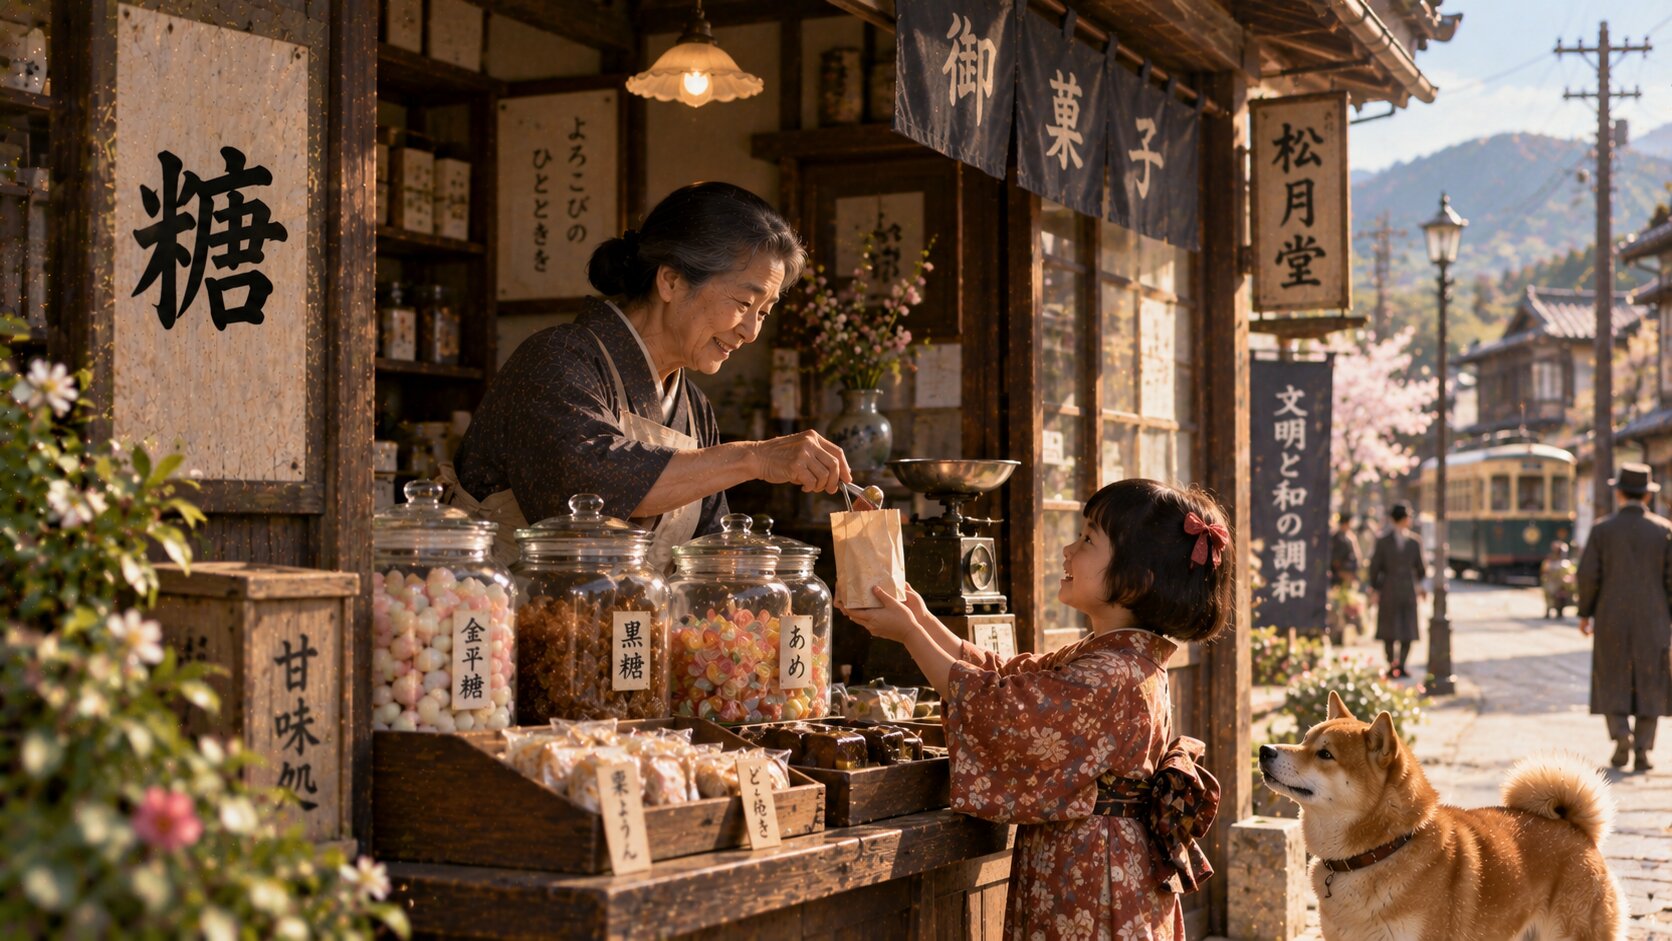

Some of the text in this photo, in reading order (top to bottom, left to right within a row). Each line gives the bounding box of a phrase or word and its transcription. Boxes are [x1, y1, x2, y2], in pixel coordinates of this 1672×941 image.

[566, 116, 588, 243] よろこびの
[942, 12, 1164, 199] 御菓子
[131, 146, 288, 331] 糖
[1272, 122, 1326, 289] 松月堂
[1271, 384, 1308, 603] 文明と和の調和
[273, 633, 321, 812] 甘味処
[459, 617, 486, 700] 金平糖
[619, 620, 645, 680] 黒糖
[788, 624, 806, 679] あめ
